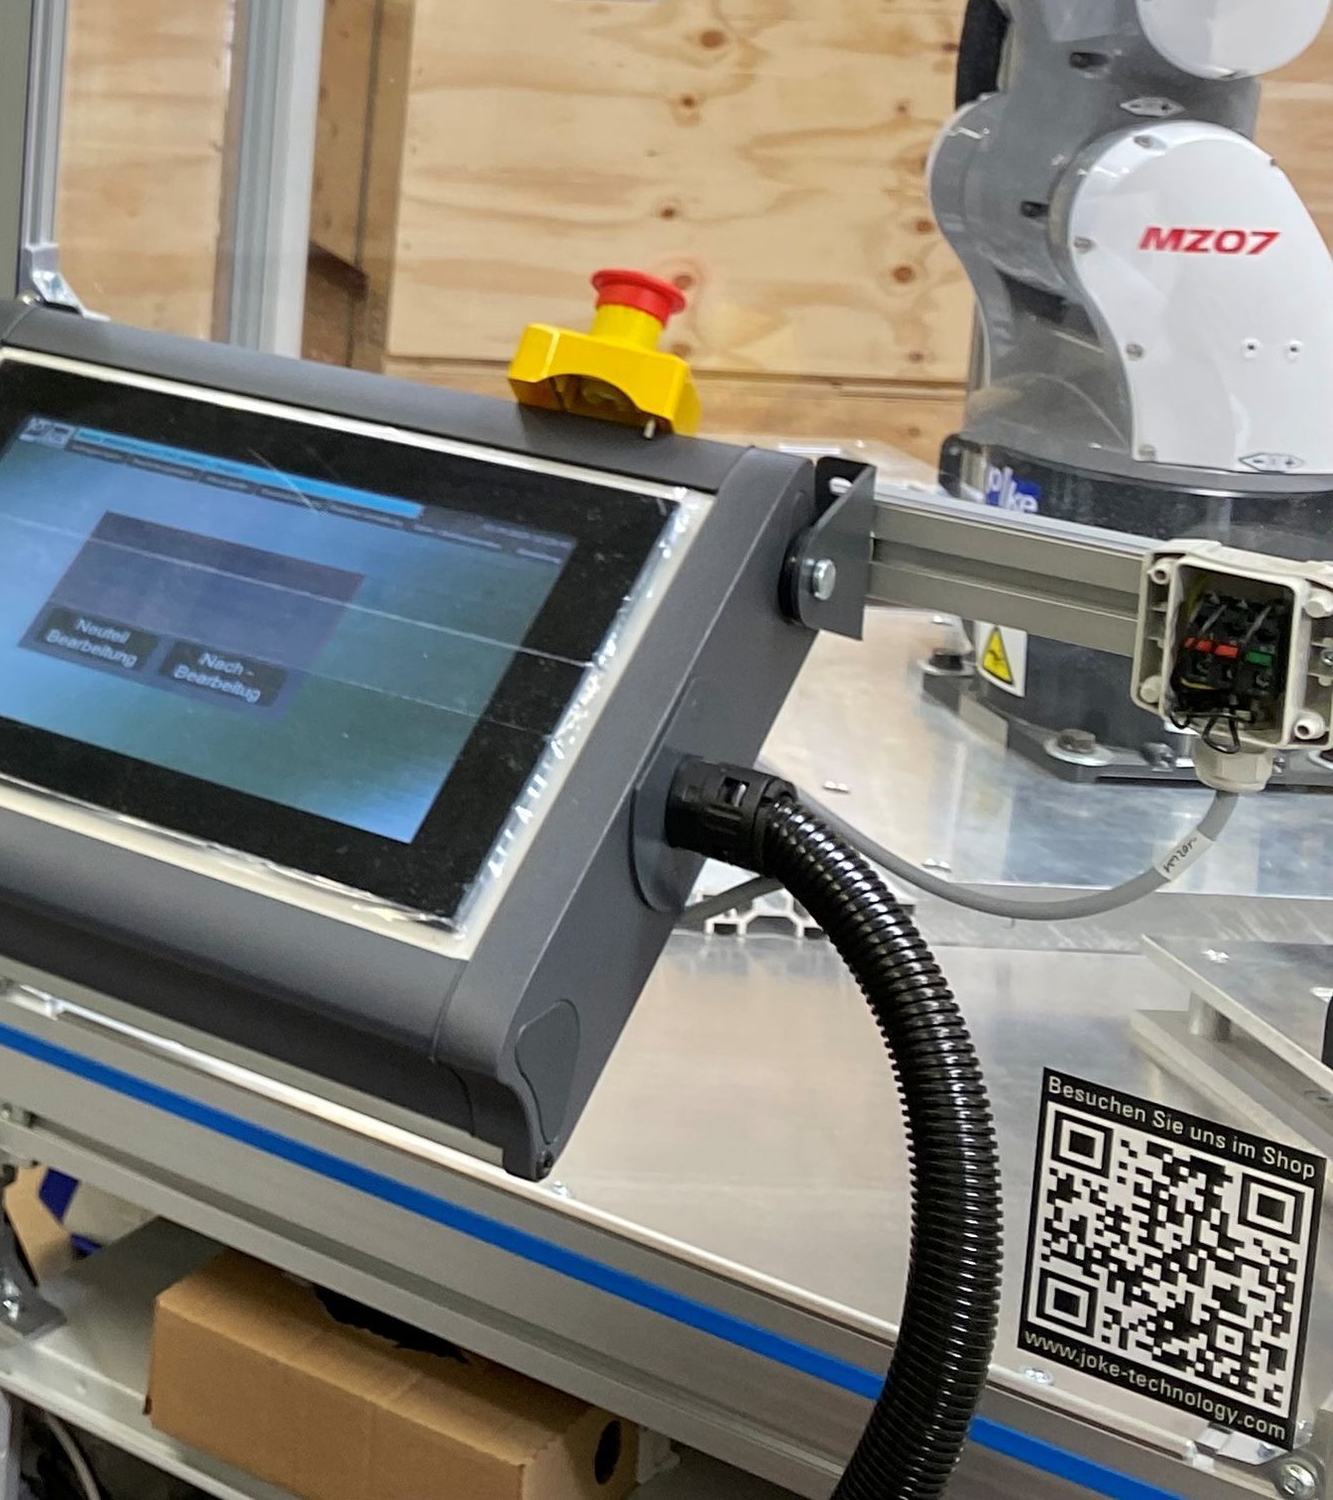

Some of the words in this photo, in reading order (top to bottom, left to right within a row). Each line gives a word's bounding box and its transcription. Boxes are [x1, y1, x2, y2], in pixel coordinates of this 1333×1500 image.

[45, 628, 138, 668] Bearbeitung
[75, 618, 130, 645] Neuteil
[198, 652, 244, 676] Nach
[1048, 1075, 1146, 1123] Besuchen
[1152, 1110, 1184, 1135] Sie
[1190, 1127, 1226, 1150] uns
[1233, 1136, 1256, 1159] im
[1262, 1146, 1315, 1180] Shop
[1023, 1329, 1286, 1441] www.joke-technology.com
